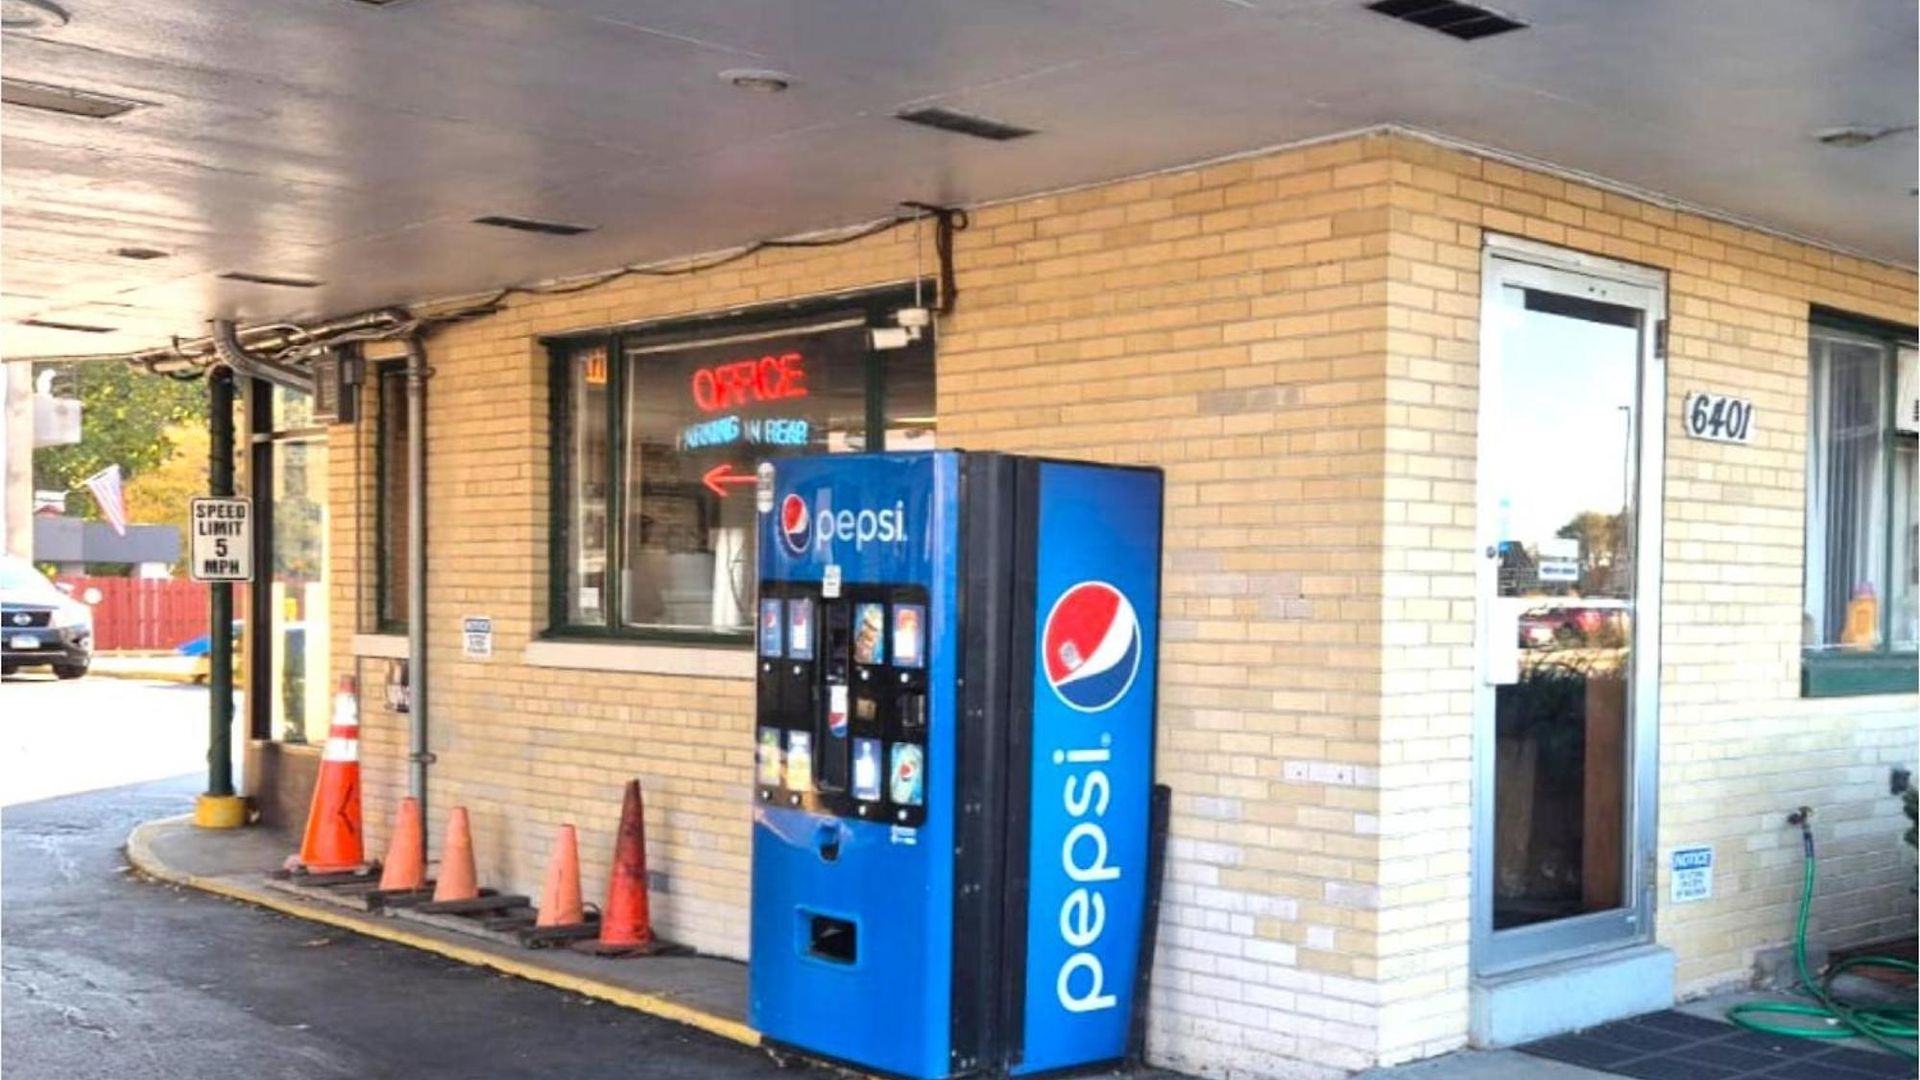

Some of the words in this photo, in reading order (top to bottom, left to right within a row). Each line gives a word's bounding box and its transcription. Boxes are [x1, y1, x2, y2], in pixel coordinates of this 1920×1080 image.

[693, 352, 808, 412] OFFICE
[1691, 394, 1752, 440] 6401
[196, 504, 246, 519] SPEED
[815, 499, 905, 552] pepsi
[199, 520, 243, 536] LIMIT
[215, 538, 228, 557] 5
[204, 560, 240, 575] MPH
[1053, 744, 1121, 1013] pepsi
